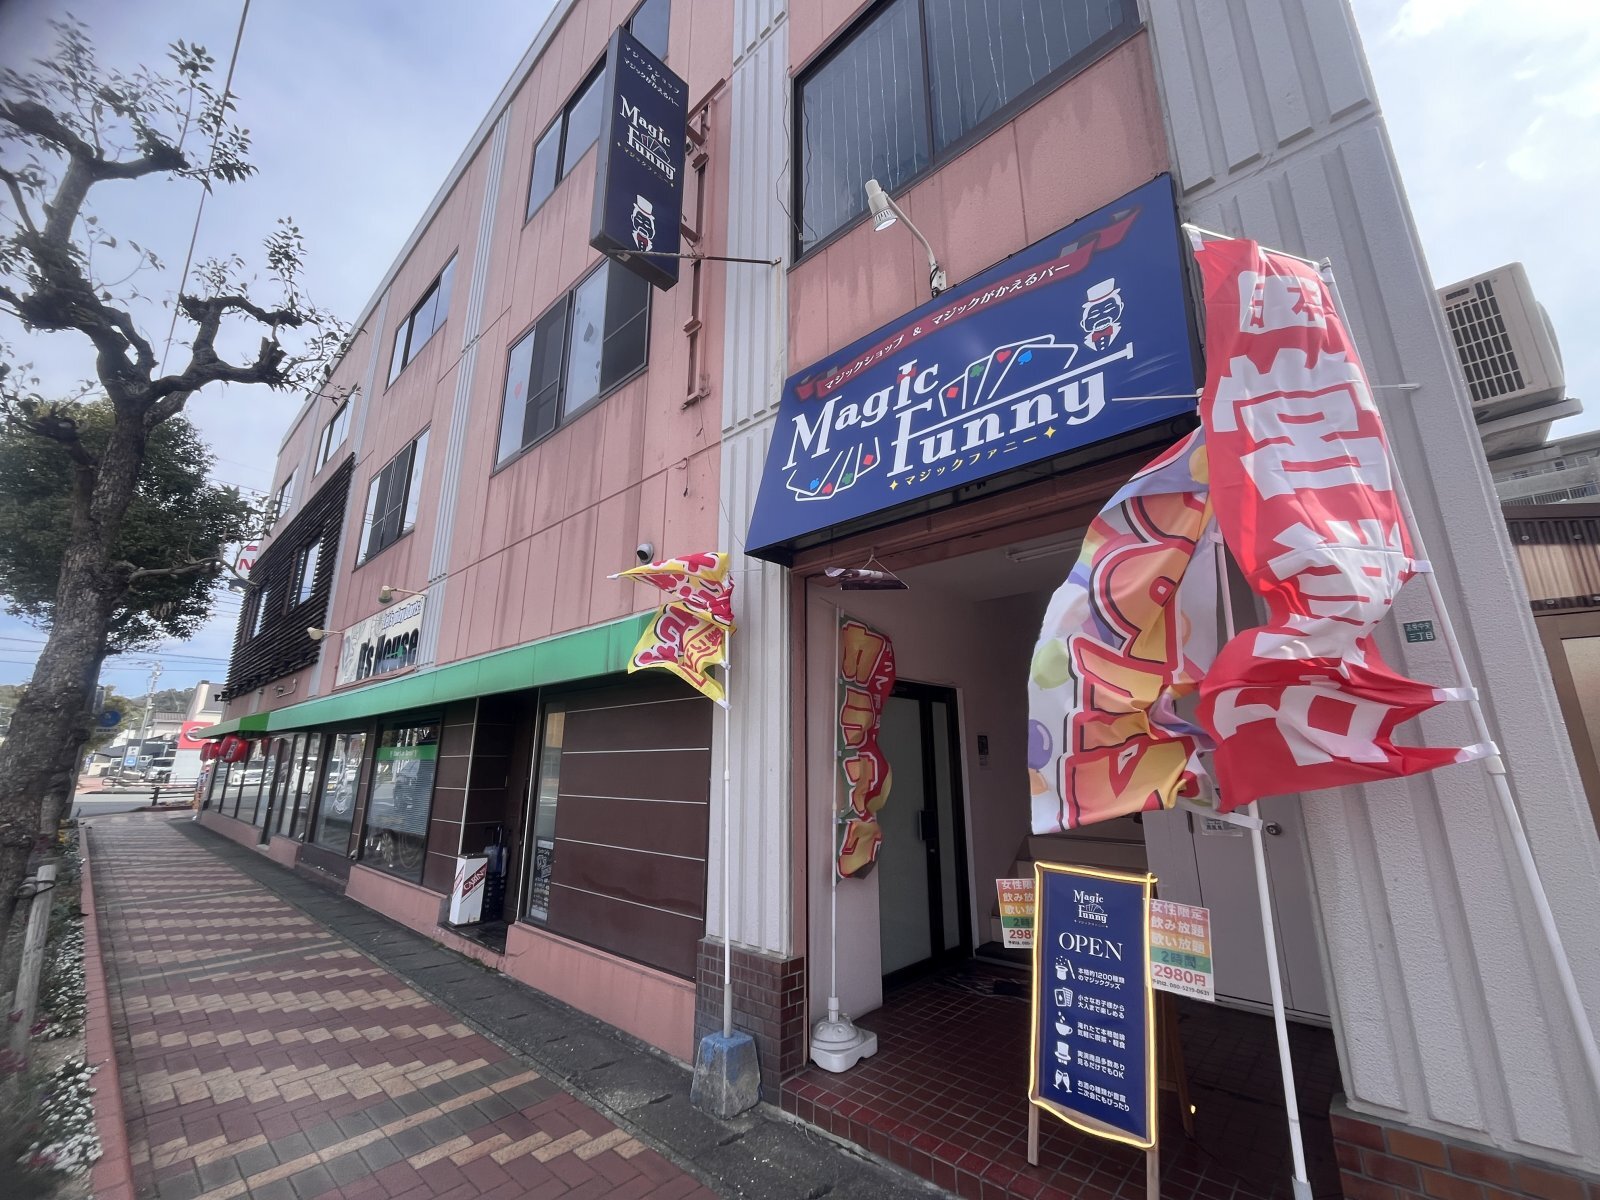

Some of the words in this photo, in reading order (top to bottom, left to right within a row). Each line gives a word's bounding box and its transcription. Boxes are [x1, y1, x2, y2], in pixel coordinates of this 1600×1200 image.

[620, 94, 671, 147] Magic
[627, 124, 676, 180] Funny
[824, 334, 904, 390] マジックショップ
[912, 326, 922, 335] &
[931, 262, 1072, 326] マジックがかえるバー
[782, 358, 939, 471] Magic
[886, 344, 1135, 478] Funny
[905, 437, 1040, 486] マジックファニー
[1074, 890, 1104, 903] Magic
[1078, 905, 1108, 923] Funny
[1151, 902, 1204, 920] 女性限定
[1009, 929, 1034, 939] 298
[1151, 915, 1204, 938] 飲み放題
[1059, 932, 1123, 961] OPEN
[1151, 932, 1205, 954] 歌い放題
[1161, 950, 1197, 969] 2時間
[1078, 968, 1125, 984] 本格的1200種類
[1078, 975, 1121, 990] のマジックグッズ
[1154, 964, 1206, 987] 2980円
[1078, 995, 1125, 1012] 小さなお子様から
[1078, 1002, 1125, 1019] 大人まで楽しめる
[1077, 1057, 1125, 1080] 見るだけでもOK
[1077, 1080, 1126, 1103] お酒の種類が豊富
[1077, 1087, 1130, 1112] 二次会にもぴったり
